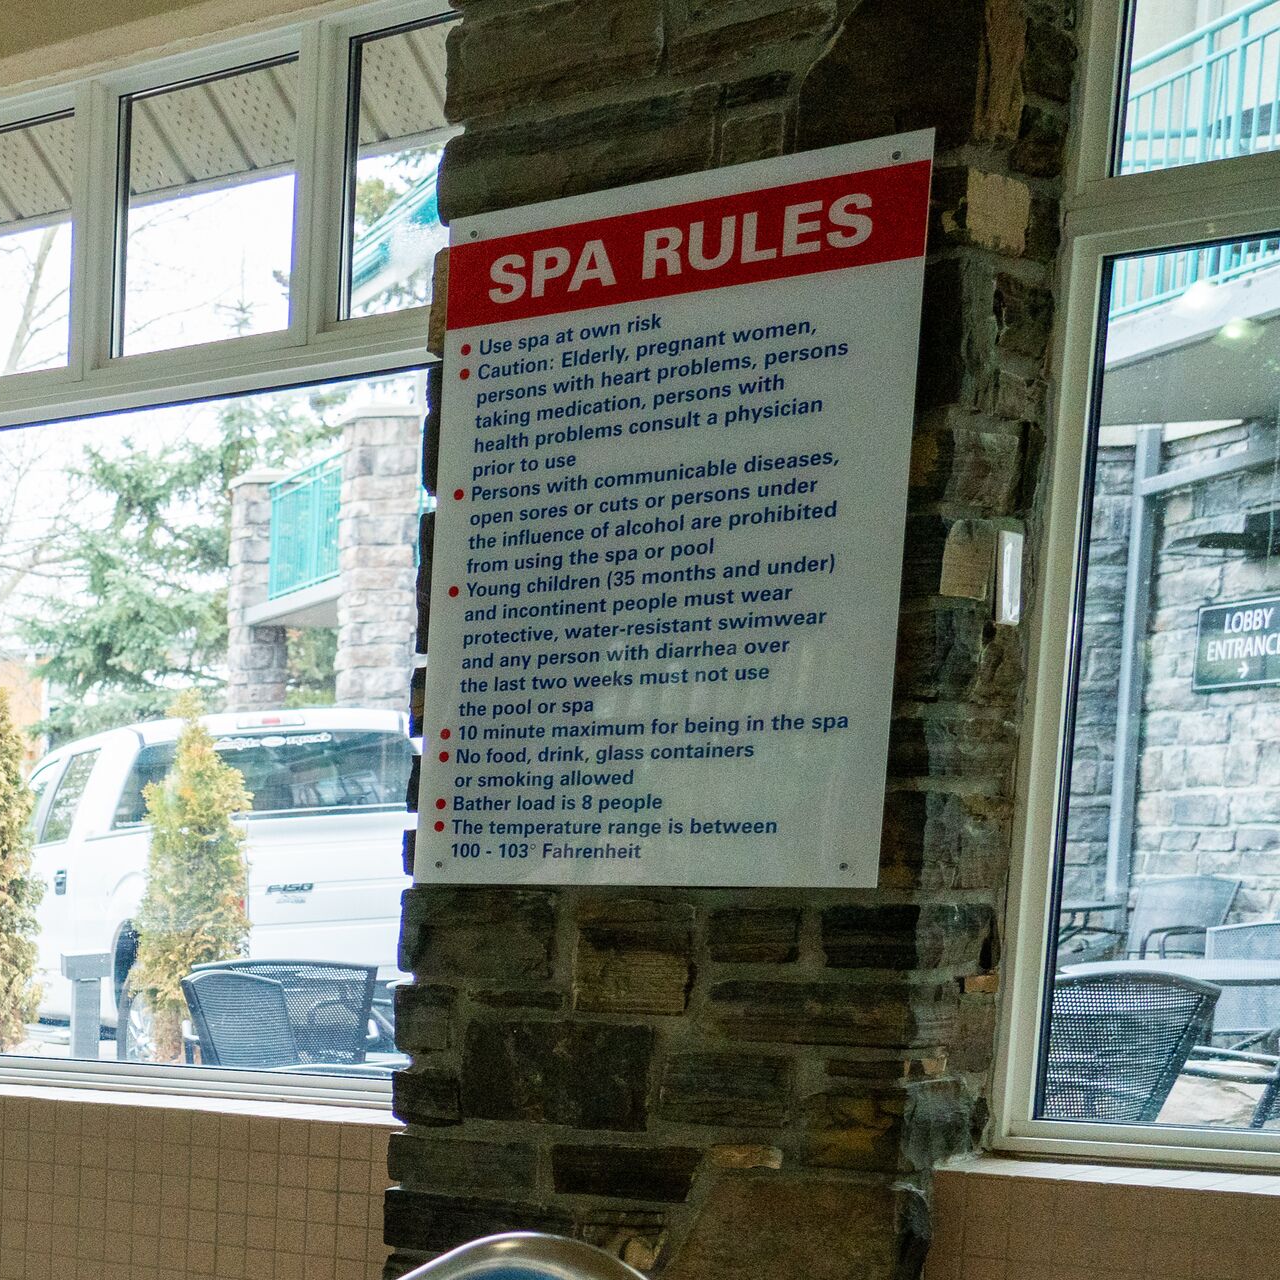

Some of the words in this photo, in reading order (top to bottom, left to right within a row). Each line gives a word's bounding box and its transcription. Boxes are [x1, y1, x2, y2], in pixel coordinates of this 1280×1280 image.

[489, 240, 615, 303] SPA
[642, 194, 872, 279] RULES
[478, 358, 554, 380] Caution:
[562, 345, 629, 368] Elderly,
[636, 331, 726, 361] pregnant
[732, 321, 816, 343] women,
[480, 339, 512, 356] Use
[518, 334, 549, 352] spa
[556, 328, 574, 344] at
[580, 323, 620, 340] own
[627, 313, 661, 333] risk
[477, 384, 547, 408] persons
[553, 374, 594, 394] with
[601, 367, 651, 387] heart
[657, 356, 756, 384] problems,
[764, 343, 848, 370] persons
[475, 410, 530, 429] taking
[537, 395, 645, 421] medication,
[653, 385, 731, 410] persons
[738, 374, 784, 395] with
[474, 432, 528, 453] health
[535, 424, 622, 450] problems
[628, 411, 700, 434] consult
[707, 413, 718, 425] a
[725, 398, 823, 427] physician
[471, 484, 540, 502] Persons
[547, 475, 588, 493] with
[594, 459, 737, 489] communicable
[744, 452, 839, 473] diseases,
[472, 460, 515, 481] prior
[520, 458, 538, 472] to
[545, 455, 576, 469] use
[470, 511, 513, 529] open
[520, 505, 568, 521] sores
[574, 503, 594, 515] or
[599, 497, 638, 513] cuts
[645, 495, 665, 508] or
[671, 487, 750, 510] persons
[758, 478, 818, 497] under
[468, 534, 496, 550] the
[503, 528, 584, 547] influence
[591, 522, 609, 539] of
[615, 514, 684, 537] alcohol
[691, 516, 722, 530] are
[729, 500, 837, 531] prohibited
[467, 558, 508, 574] from
[515, 553, 563, 571] using
[569, 549, 599, 565] the
[605, 549, 638, 565] spa
[644, 547, 665, 559] or
[671, 538, 714, 561] pool
[467, 582, 520, 598] Young
[527, 575, 600, 593] children
[607, 570, 635, 590] (35
[642, 565, 716, 584] months
[723, 560, 760, 579] and
[768, 553, 835, 575] under)
[465, 605, 496, 622] and
[503, 599, 606, 619] incontinent
[613, 592, 677, 615] people
[684, 590, 734, 607] must
[741, 588, 793, 603] wear
[1224, 607, 1275, 634] LOBBY
[463, 626, 558, 649] protective,
[565, 617, 712, 639] water-resistant
[718, 612, 827, 630] swimwear
[462, 653, 494, 669] and
[499, 655, 532, 670] any
[537, 651, 600, 669] person
[606, 644, 649, 661] with
[656, 640, 736, 660] diarrhea
[744, 640, 790, 655] over
[460, 678, 488, 693] the
[494, 676, 526, 691] last
[531, 676, 567, 690] two
[574, 670, 633, 688] weeks
[639, 669, 689, 685] must
[693, 667, 728, 683] not
[735, 667, 770, 681] use
[459, 701, 486, 716] the
[493, 699, 531, 719] pool
[538, 702, 556, 714] or
[562, 700, 594, 716] spa
[459, 725, 477, 740] 10
[483, 724, 545, 739] minute
[552, 720, 645, 737] maximum
[651, 718, 679, 734] for
[684, 717, 739, 736] being
[747, 715, 764, 731] in
[771, 714, 805, 731] the
[812, 716, 848, 733] spa
[456, 749, 481, 764] No
[486, 747, 531, 765] food,
[538, 746, 589, 763] drink,
[596, 745, 644, 764] glass
[649, 742, 754, 759] containers
[454, 776, 472, 787] or
[478, 771, 554, 790] smoking
[560, 769, 634, 786] allowed
[453, 796, 511, 811] Bather
[517, 795, 555, 810] load
[562, 795, 575, 810] is
[582, 795, 592, 810] 8
[598, 794, 663, 813] people
[452, 819, 483, 834] The
[489, 821, 602, 838] temperature
[608, 823, 661, 838] range
[668, 818, 683, 834] is
[690, 818, 777, 834] between
[451, 843, 480, 858] 100
[543, 843, 642, 861] Fahrenheit
